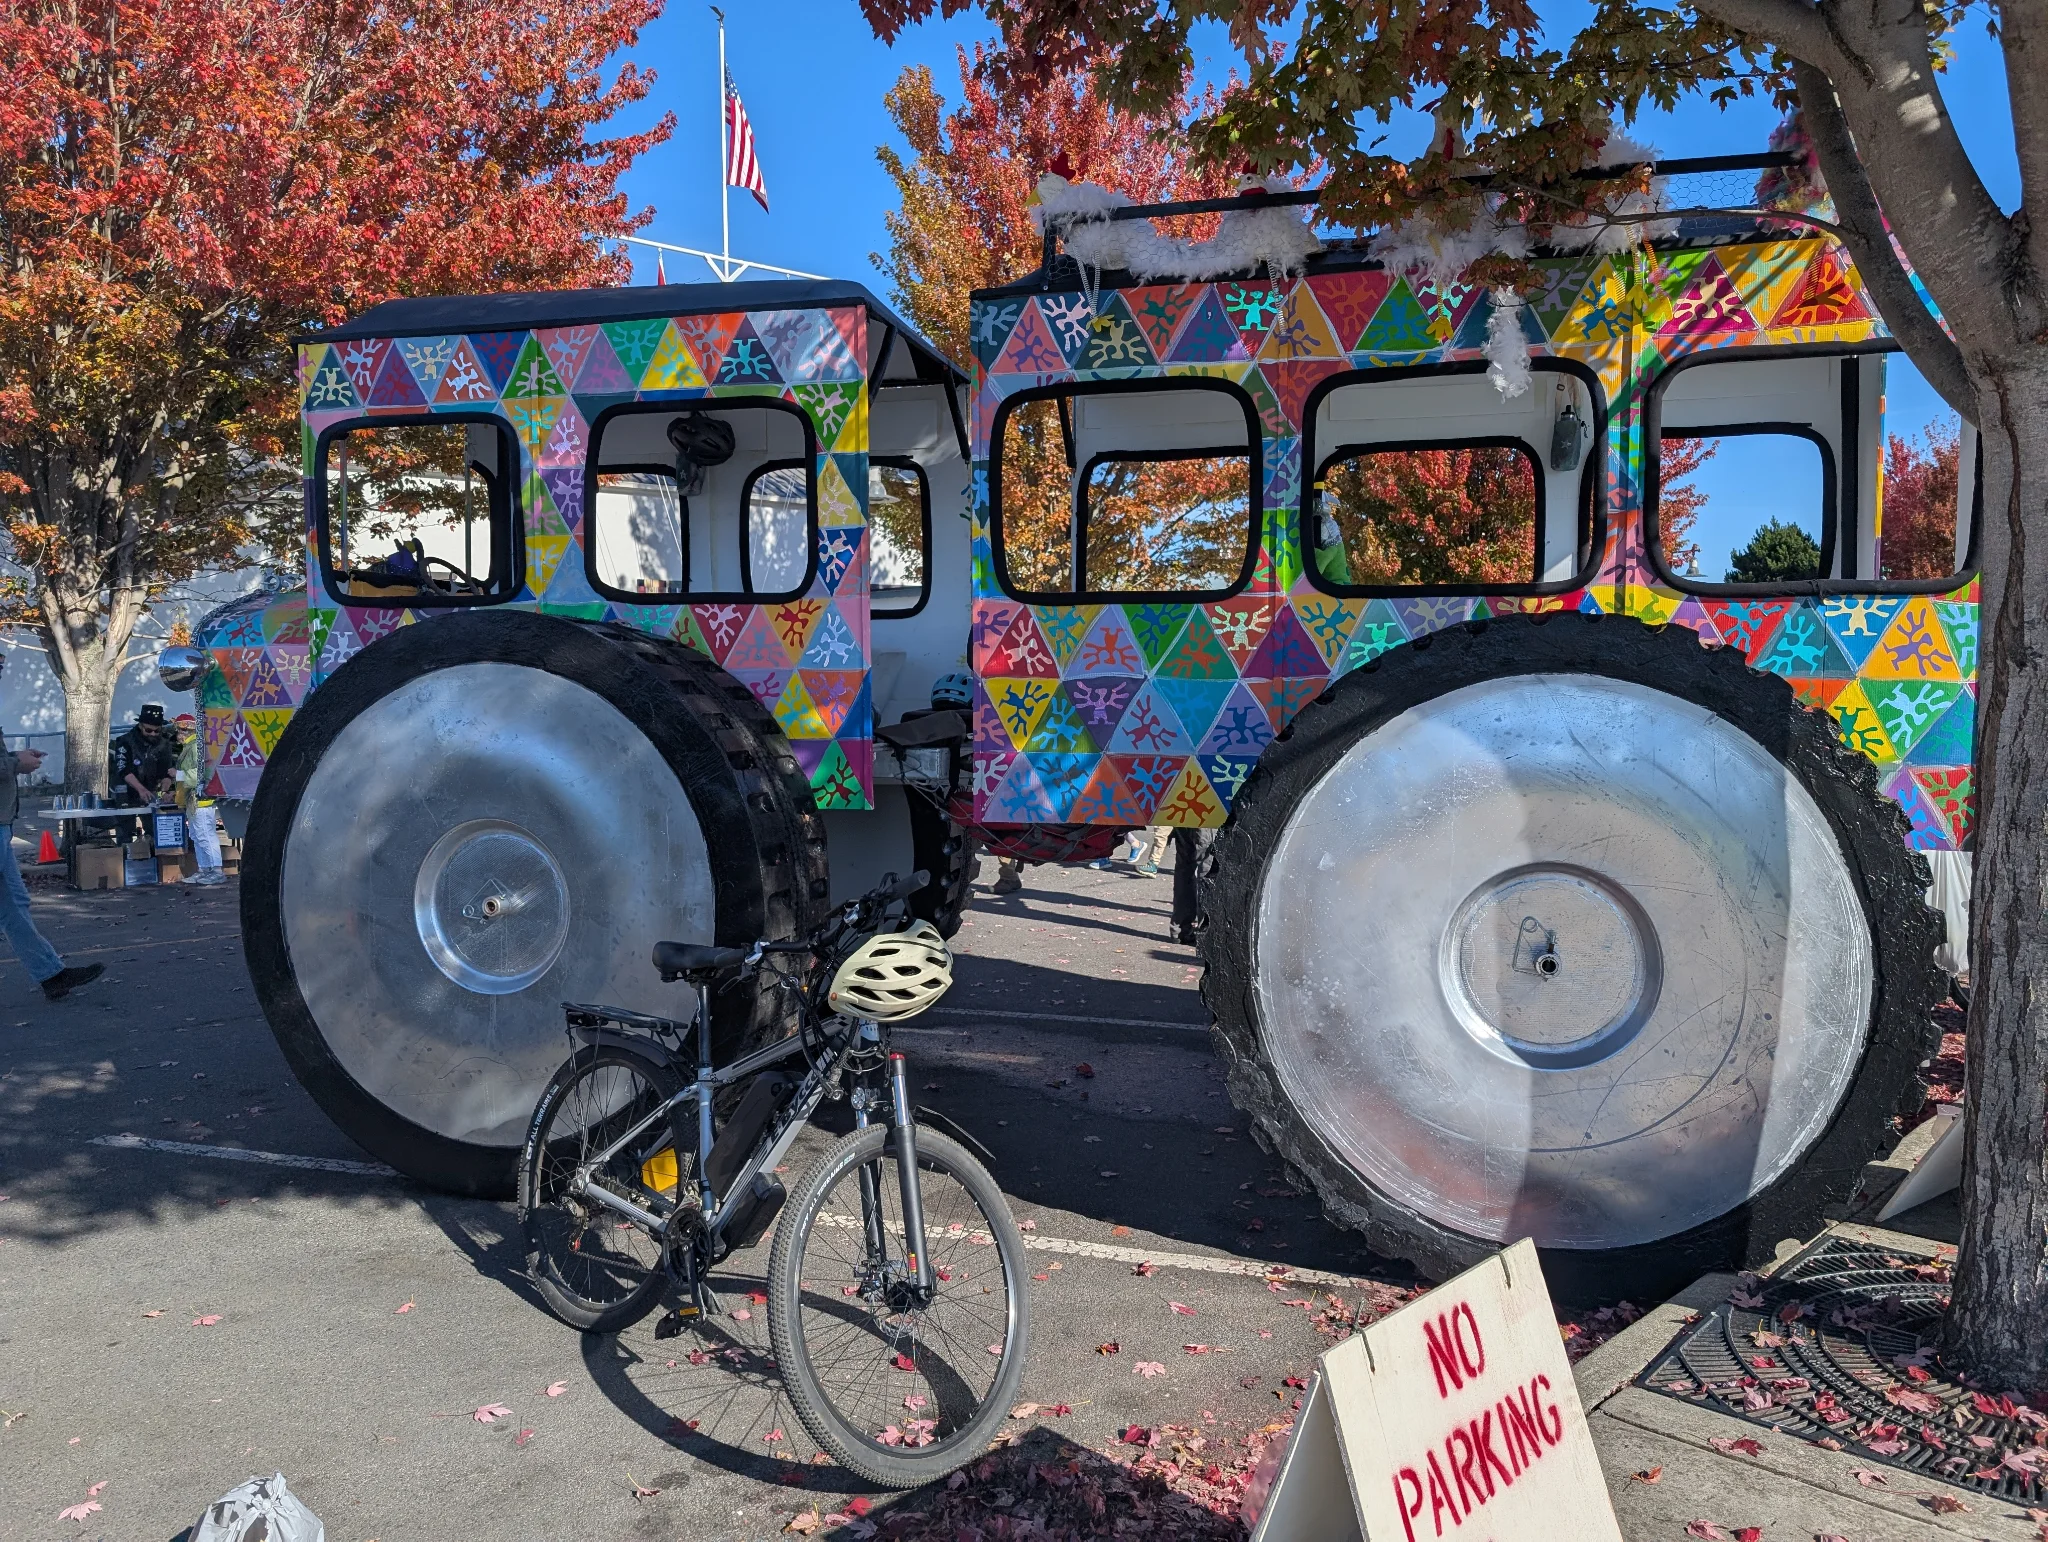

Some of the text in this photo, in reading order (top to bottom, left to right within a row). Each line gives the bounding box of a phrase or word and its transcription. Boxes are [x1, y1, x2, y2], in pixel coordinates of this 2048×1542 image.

[530, 1126, 539, 1141] ALL
[535, 1093, 553, 1126] TERRAINS
[1423, 1301, 1485, 1399] NO
[1392, 1374, 1562, 1542] PARKING
